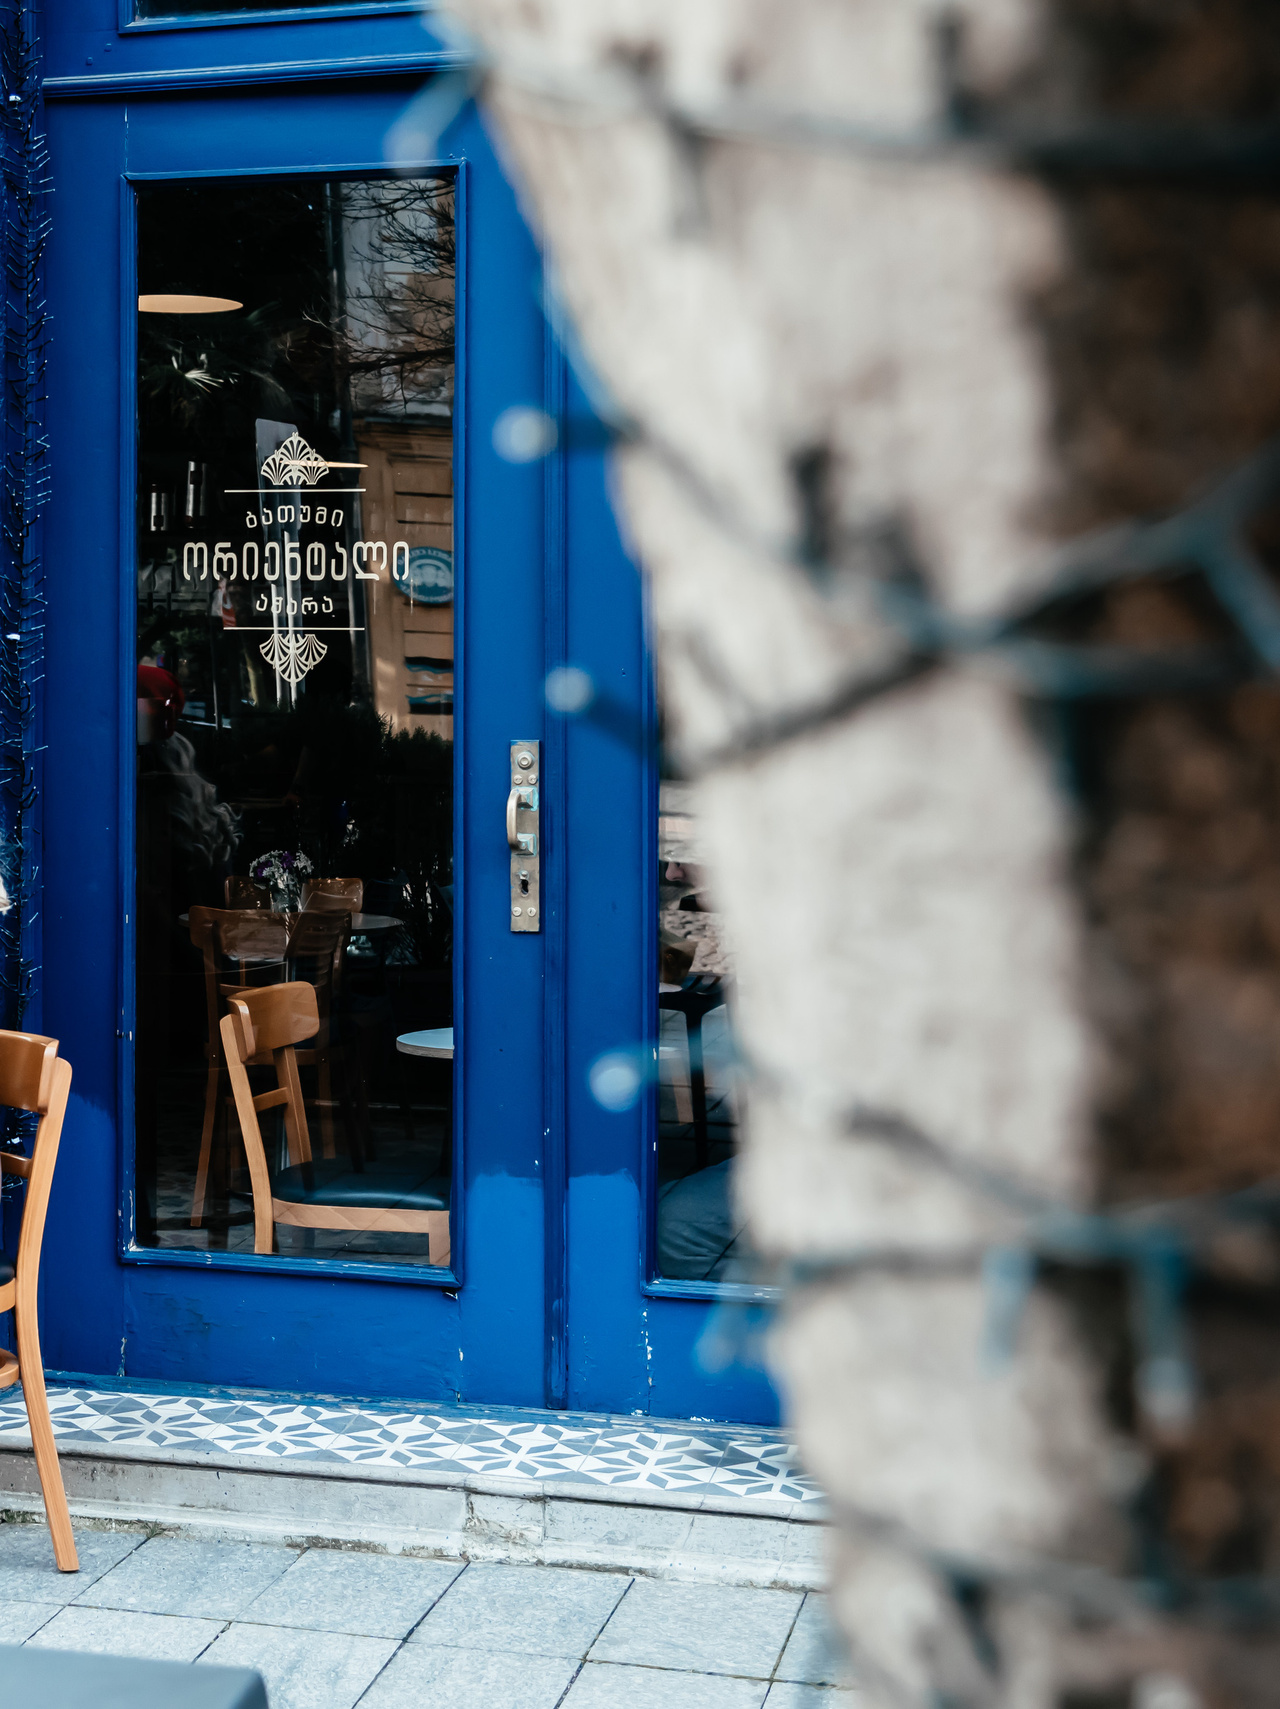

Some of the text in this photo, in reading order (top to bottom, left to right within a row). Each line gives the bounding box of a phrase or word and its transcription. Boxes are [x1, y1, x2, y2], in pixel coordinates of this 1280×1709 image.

[245, 504, 344, 529] ბათუმი
[182, 541, 410, 582] ორიენტალი
[255, 593, 334, 616] აჭარა
